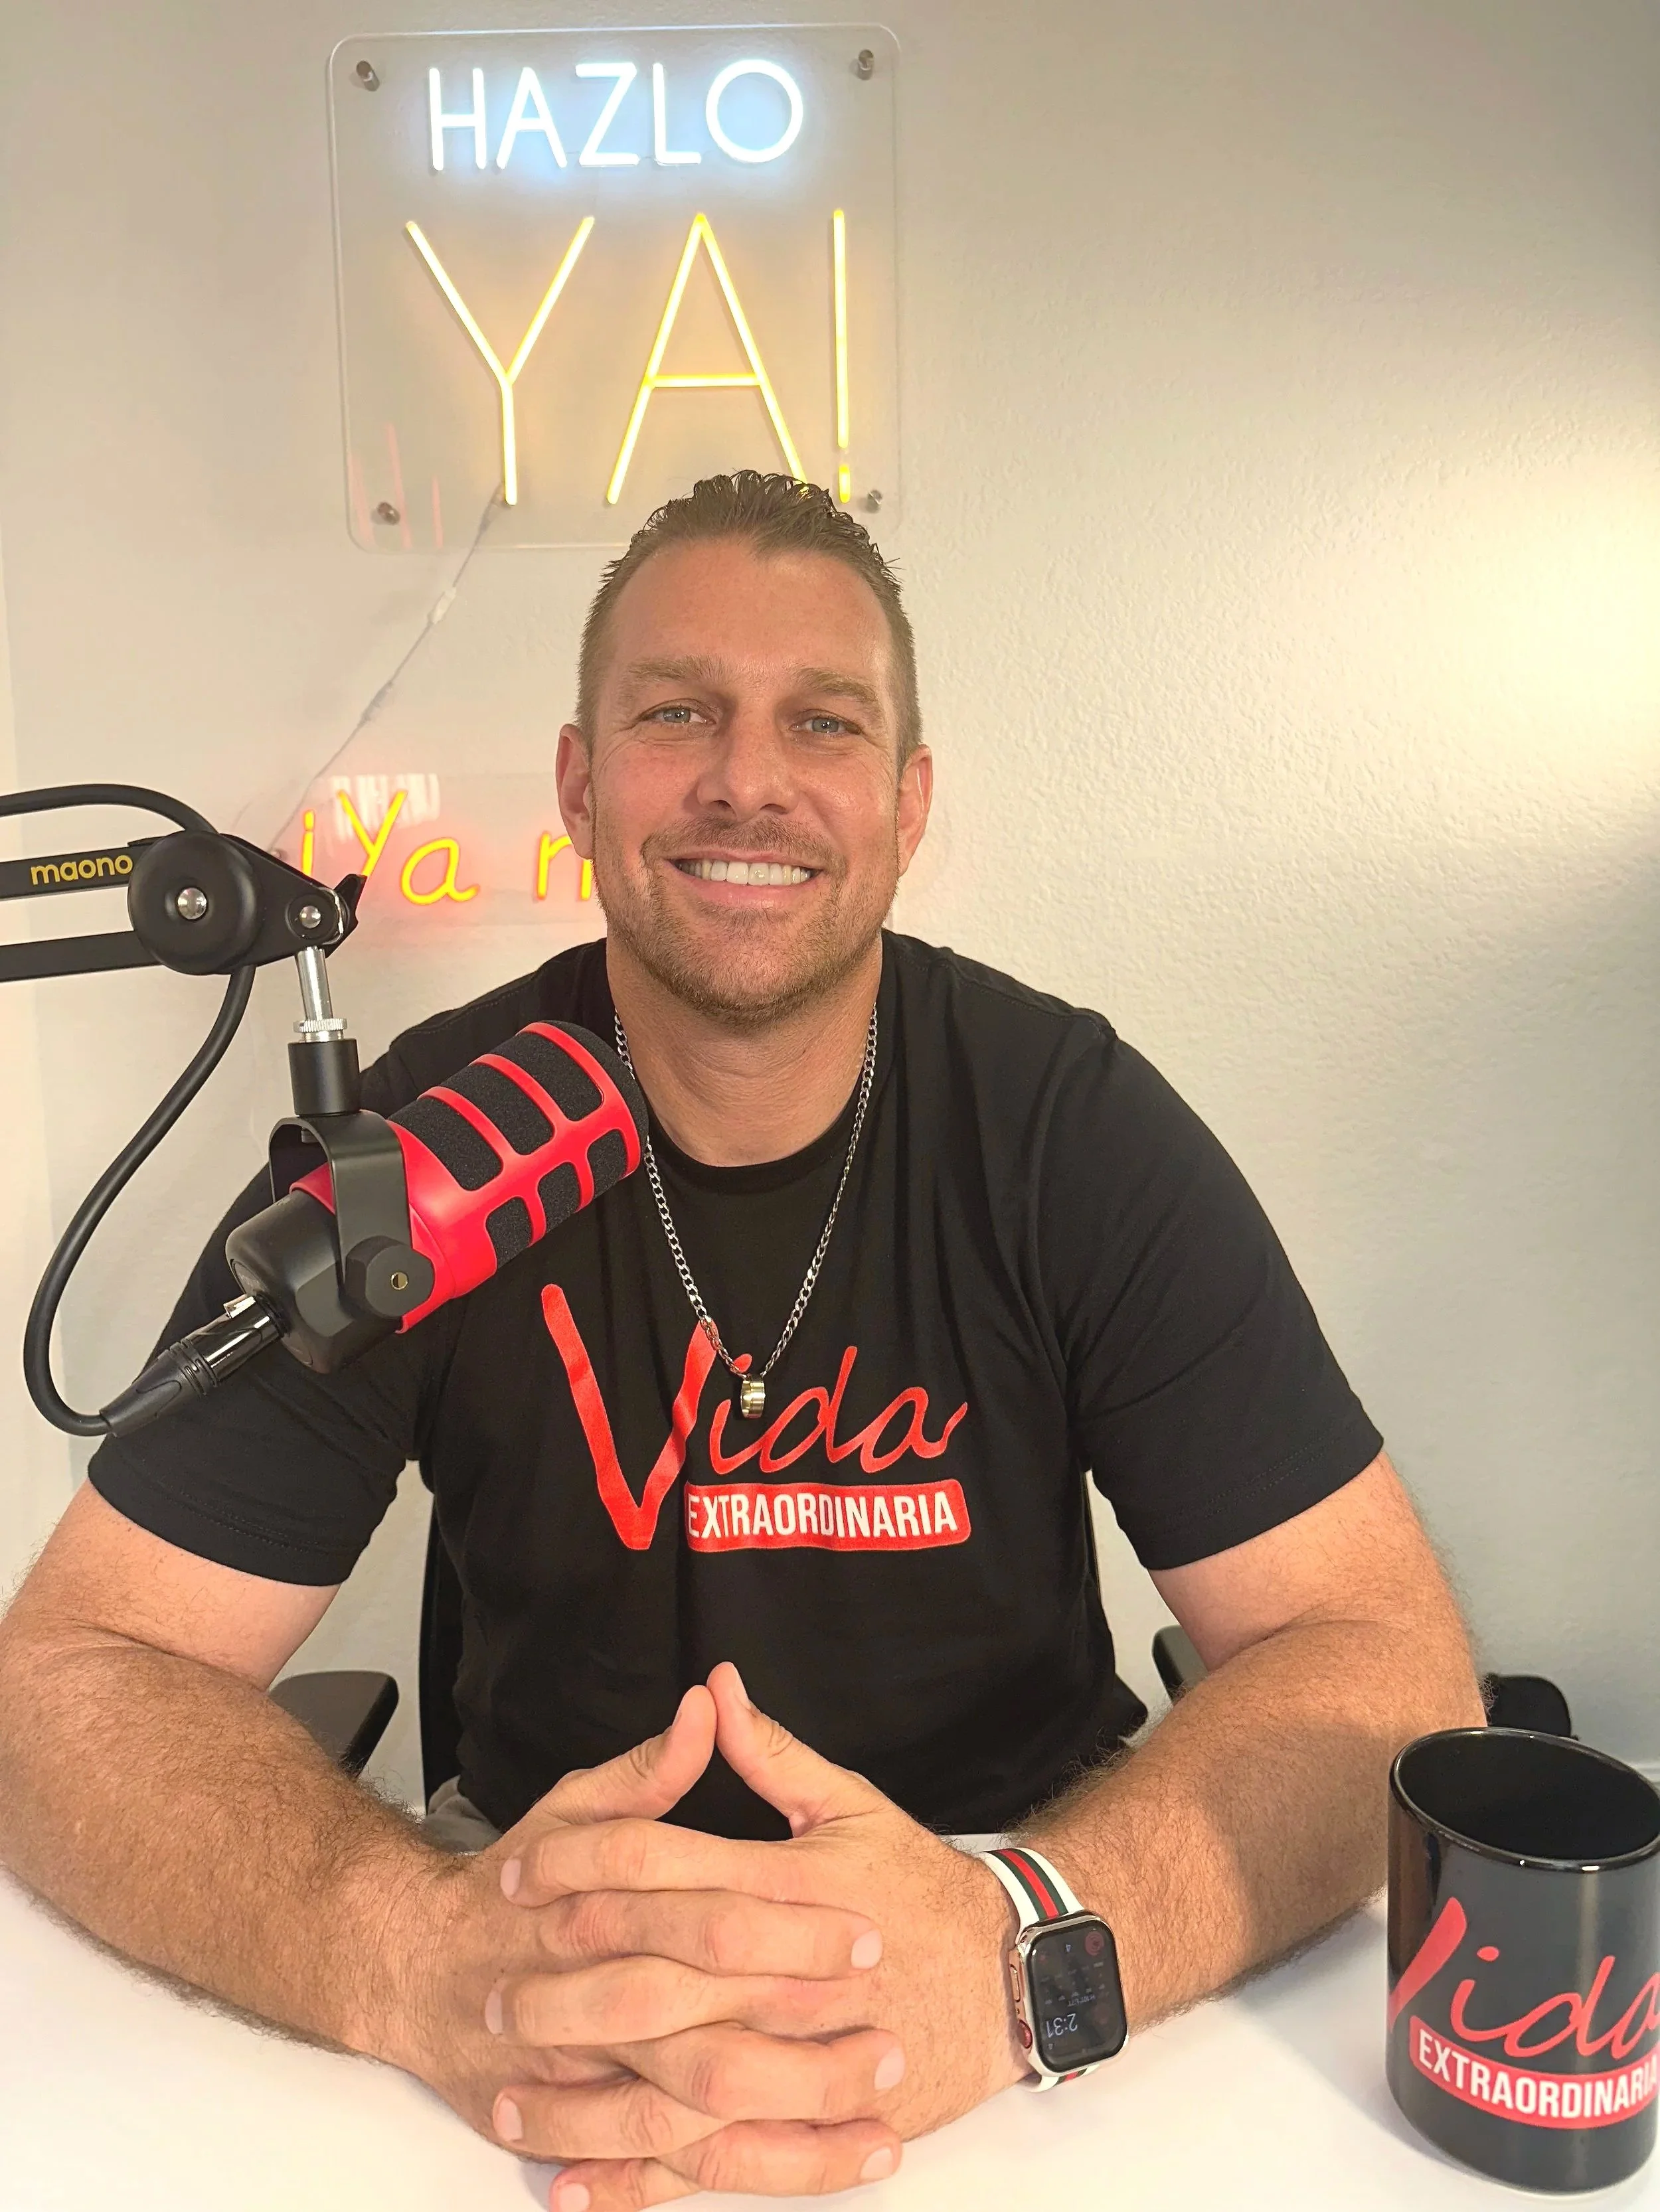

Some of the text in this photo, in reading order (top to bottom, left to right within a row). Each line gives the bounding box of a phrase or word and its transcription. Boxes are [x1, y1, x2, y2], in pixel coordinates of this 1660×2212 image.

[429, 59, 803, 171] HAZLO
[406, 208, 851, 505] YA!
[31, 855, 133, 885] maono
[541, 1284, 967, 1550] Vida
[688, 1492, 957, 1539] EXTRAORDINARIA
[1046, 2013, 1078, 2038] 2:31
